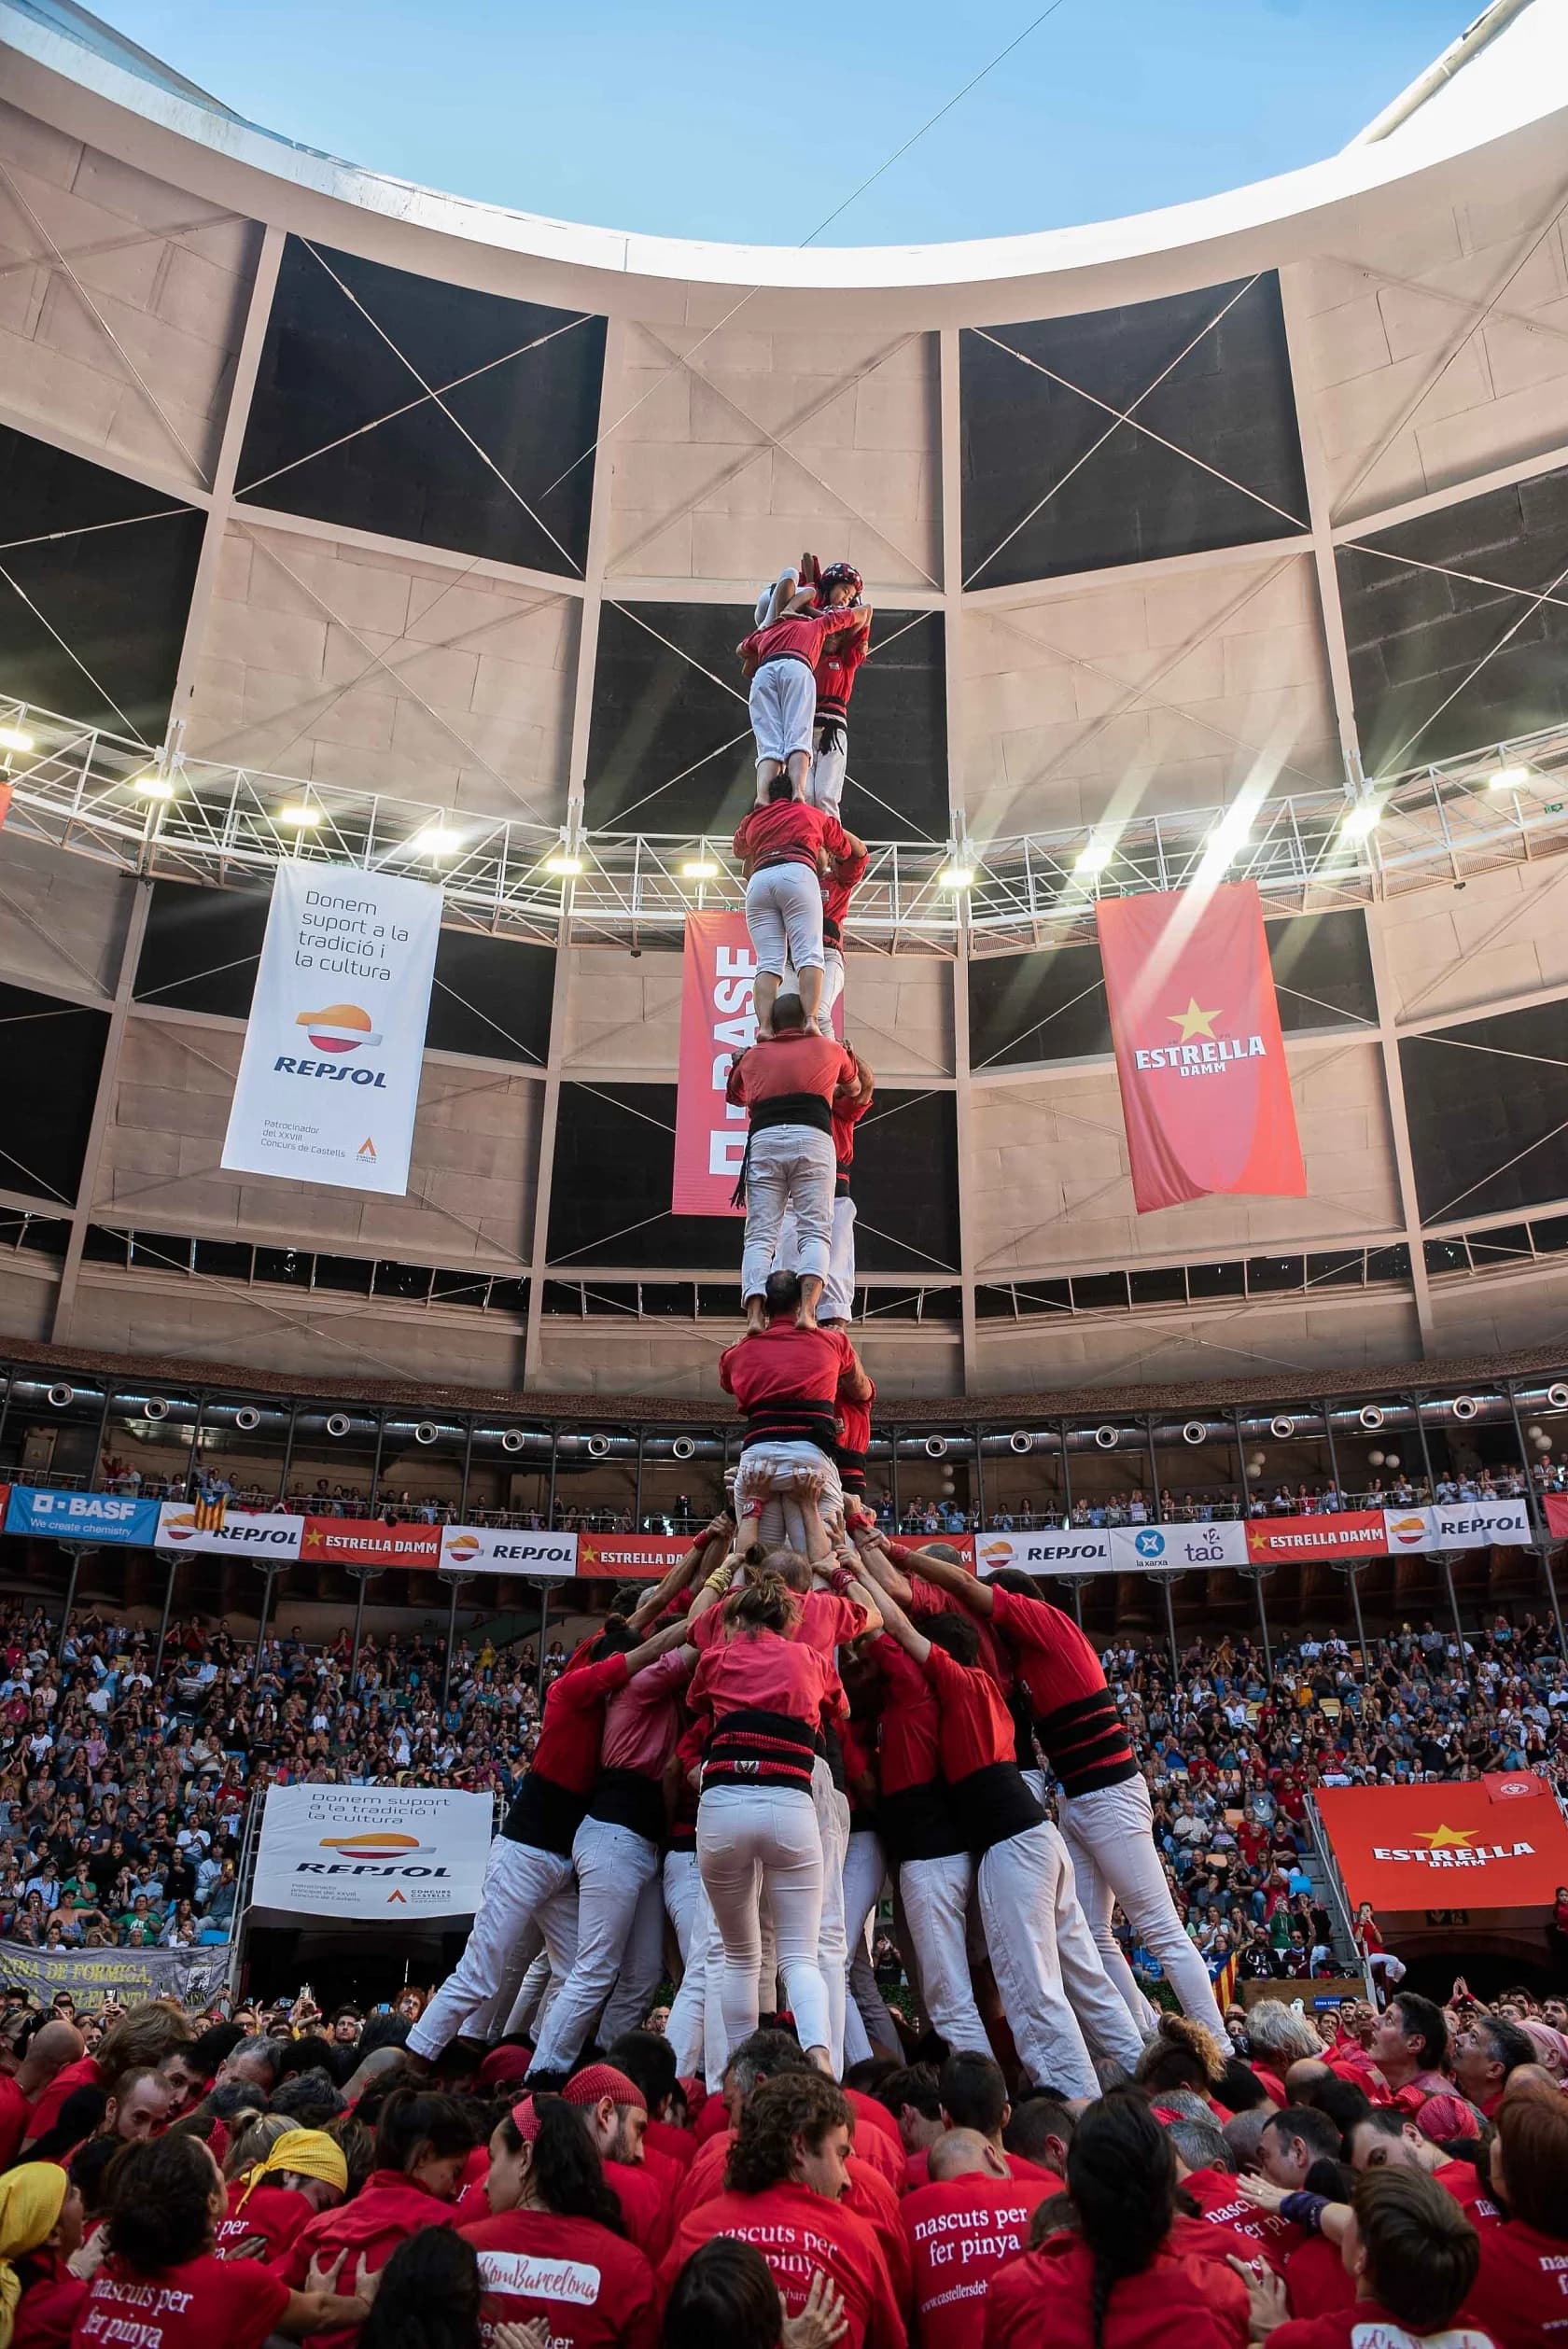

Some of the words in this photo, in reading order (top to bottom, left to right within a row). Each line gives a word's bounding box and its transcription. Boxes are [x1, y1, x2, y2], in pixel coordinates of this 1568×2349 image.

[306, 890, 377, 916] Donem
[301, 913, 368, 935] suport
[372, 924, 385, 938] a
[391, 925, 410, 942] la
[298, 930, 374, 957] tradició
[380, 944, 385, 958] i
[295, 950, 313, 968] la
[319, 956, 392, 982] cultura
[1135, 1036, 1267, 1070] ESTRELLA
[273, 1056, 387, 1088] REPSOL
[1180, 1061, 1225, 1077] DAMM
[264, 1119, 319, 1134] Patrocinador
[260, 1138, 296, 1151] Concurs
[299, 1143, 309, 1152] de
[311, 1145, 345, 1158] Castells
[69, 1498, 136, 1520] BASF
[30, 1517, 46, 1529] We
[48, 1520, 81, 1531] create
[83, 1523, 132, 1538] chemistry
[213, 1525, 298, 1545] REPSOL
[1441, 1517, 1525, 1535] REPSOL
[326, 1535, 391, 1552] ESTRELLA
[395, 1540, 438, 1554] DAMM
[1269, 1532, 1337, 1549] ESTRELLA
[1340, 1528, 1384, 1544] DAMM
[493, 1545, 573, 1562] REPSOL
[600, 1552, 664, 1564] ESTRELLA
[1028, 1545, 1107, 1561] REPSOL
[1183, 1543, 1224, 1562] tac
[309, 1802, 321, 1811] a
[329, 1803, 345, 1812] la
[353, 1805, 426, 1816] tradició
[312, 1793, 382, 1805] Donem
[388, 1797, 450, 1808] suport
[307, 1811, 326, 1821] la
[332, 1813, 403, 1825] cultura
[1373, 1842, 1535, 1862] ESTRELLA
[295, 1862, 452, 1878] REPSOL
[1429, 1859, 1486, 1867] DAMM
[217, 2220, 249, 2241] per
[915, 2209, 989, 2241] nascuts
[994, 2207, 1028, 2230] per
[804, 2230, 838, 2259] per
[929, 2240, 955, 2267] fer
[960, 2231, 1021, 2264] pinya
[91, 2278, 156, 2307] nascuts
[151, 2288, 194, 2316] per
[80, 2305, 108, 2333] fer
[100, 2313, 163, 2349] pinya
